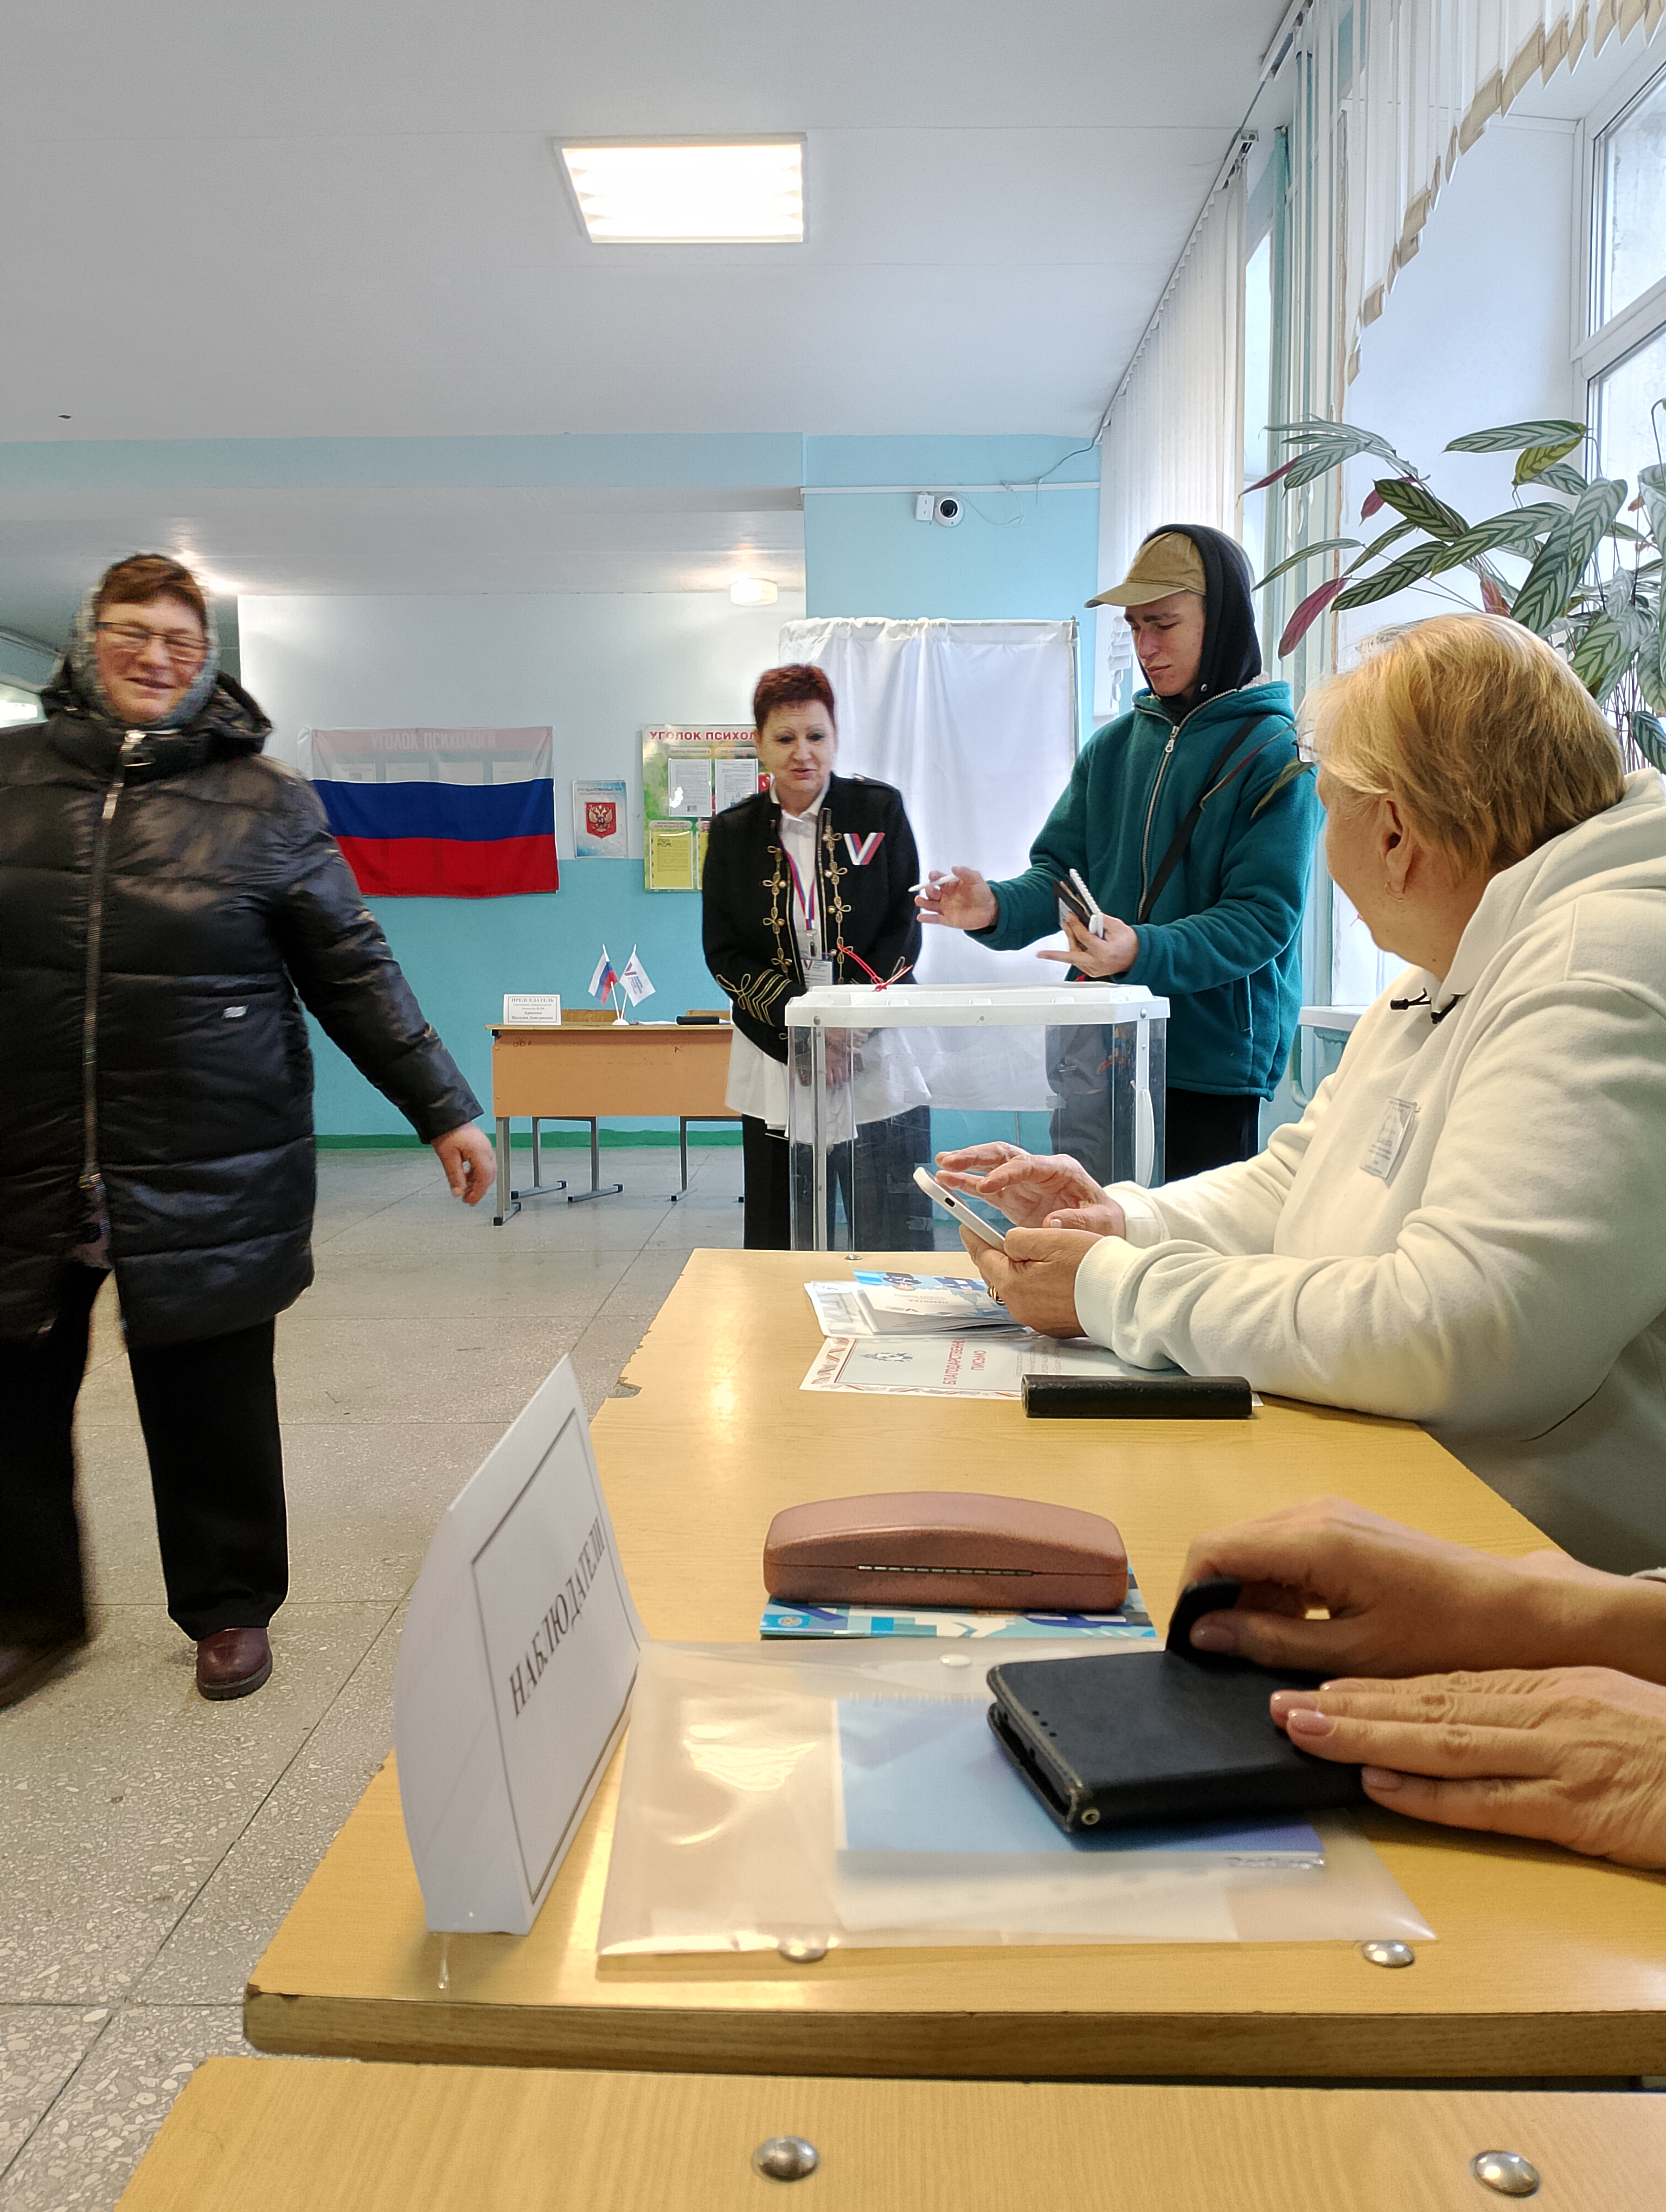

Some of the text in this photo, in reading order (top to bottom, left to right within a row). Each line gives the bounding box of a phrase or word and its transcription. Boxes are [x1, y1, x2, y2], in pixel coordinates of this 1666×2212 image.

[371, 732, 419, 750] УГОЛОК
[650, 731, 702, 741] УГОЛОК
[971, 1350, 987, 1371] ПИСЬМО
[509, 1515, 605, 1719] НАБЛЮДАТЕЛИ
